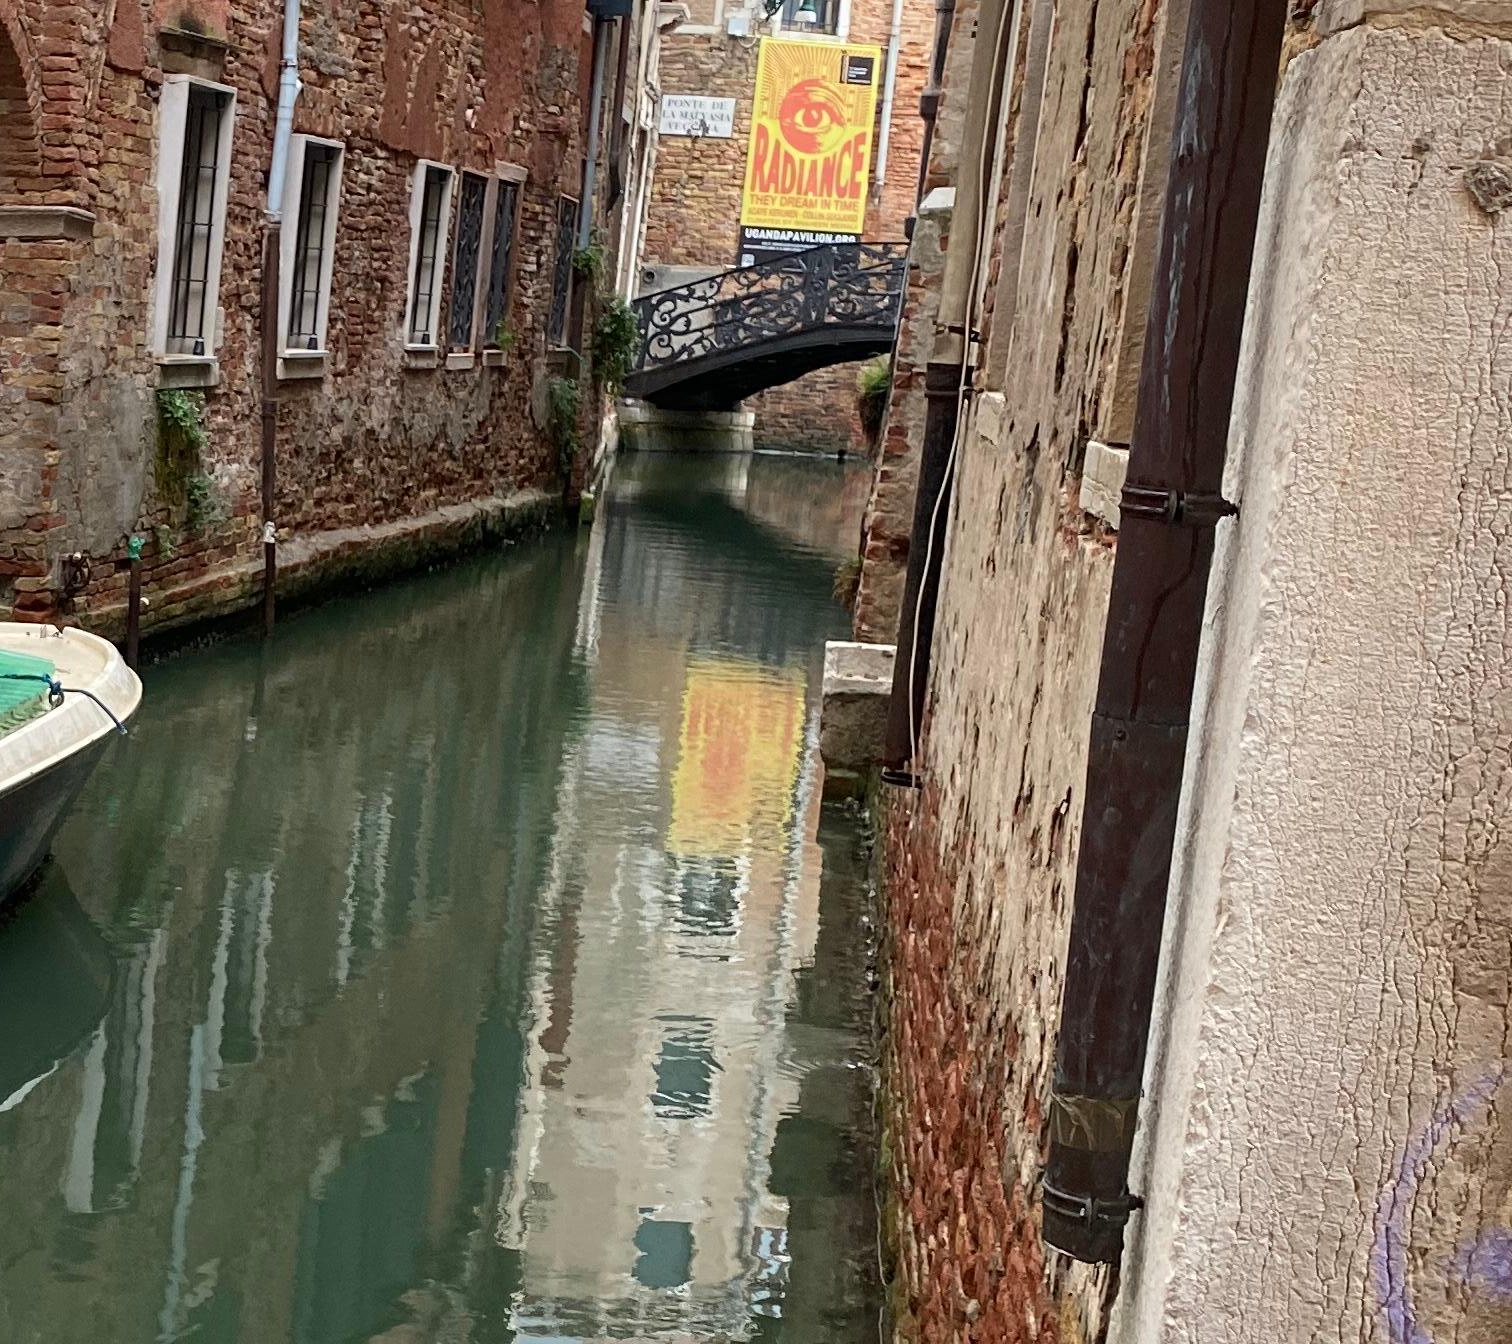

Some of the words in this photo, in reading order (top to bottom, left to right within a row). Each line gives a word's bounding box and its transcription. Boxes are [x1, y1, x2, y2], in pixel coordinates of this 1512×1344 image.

[667, 98, 705, 110] PONTE
[711, 101, 728, 110] DE
[662, 110, 676, 119] LA
[750, 122, 867, 199] RADIANCE
[749, 193, 776, 207] THEY
[779, 196, 818, 209] DREAM
[821, 199, 832, 210] IN
[833, 199, 859, 212] TIME
[744, 227, 856, 243] UGANDAPAVILION.ORG
